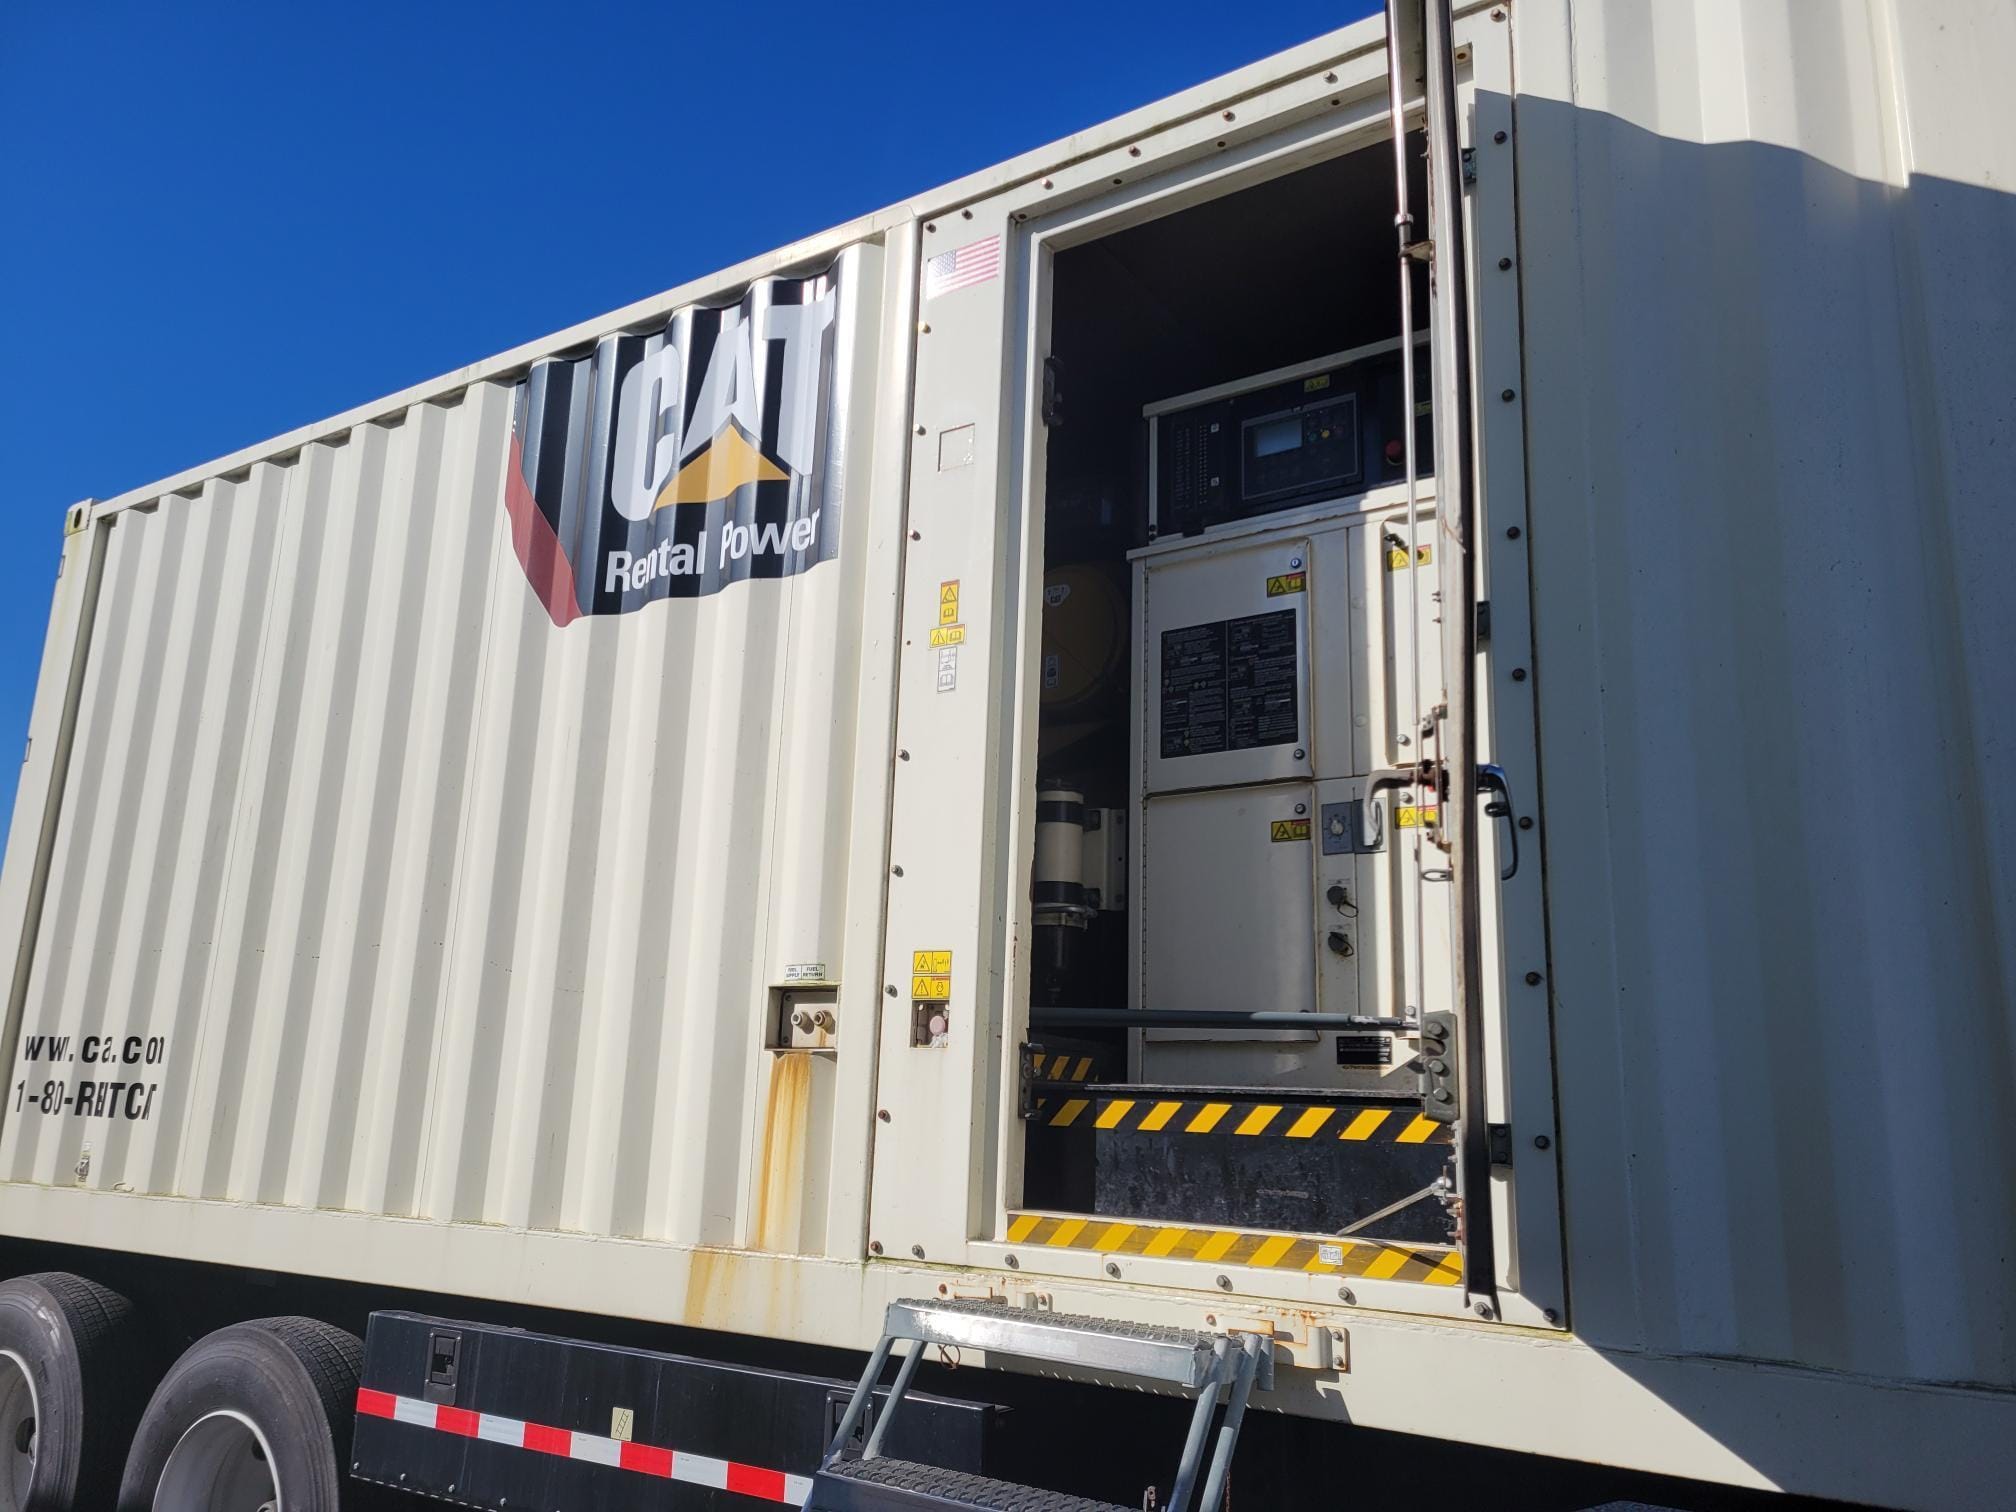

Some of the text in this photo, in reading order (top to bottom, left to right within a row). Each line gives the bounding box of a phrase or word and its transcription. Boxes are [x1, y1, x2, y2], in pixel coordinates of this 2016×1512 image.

[611, 287, 836, 522] CAT
[604, 508, 820, 593] Rental Power
